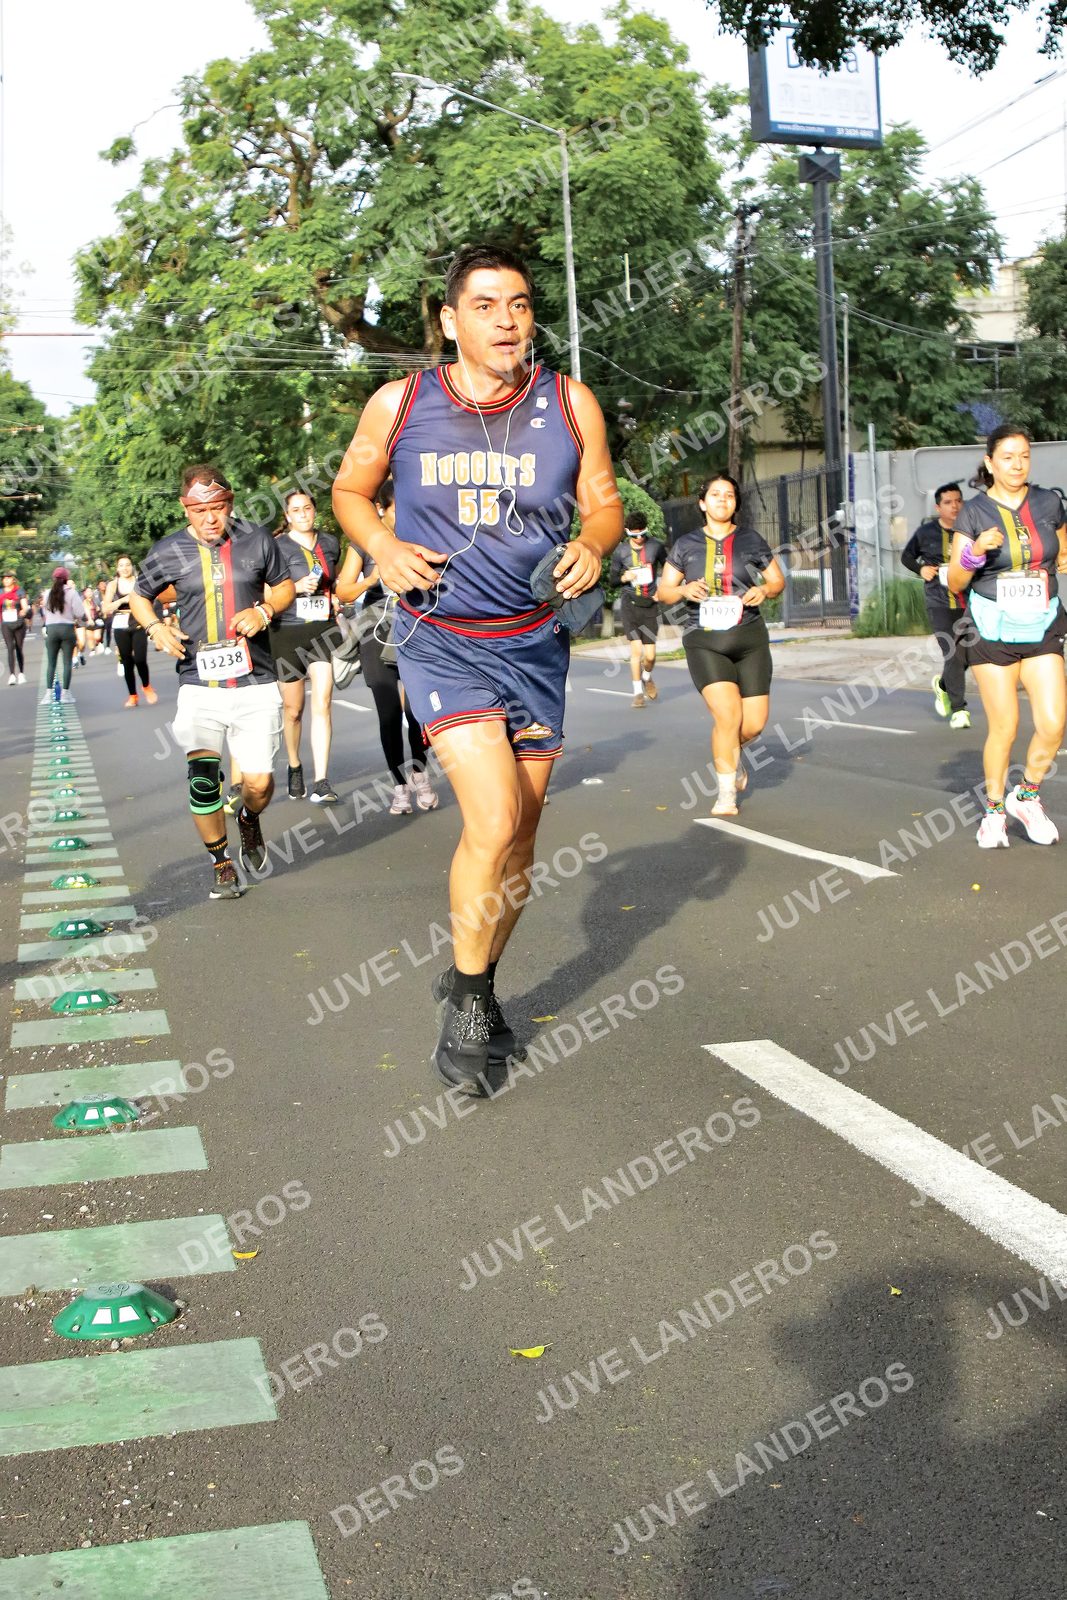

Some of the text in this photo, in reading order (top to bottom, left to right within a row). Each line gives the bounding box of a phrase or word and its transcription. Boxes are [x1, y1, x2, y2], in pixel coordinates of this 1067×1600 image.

[420, 451, 536, 486] NUGGETS
[458, 489, 500, 526] 55
[1002, 584, 1042, 598] 10923
[200, 651, 243, 670] 13238
